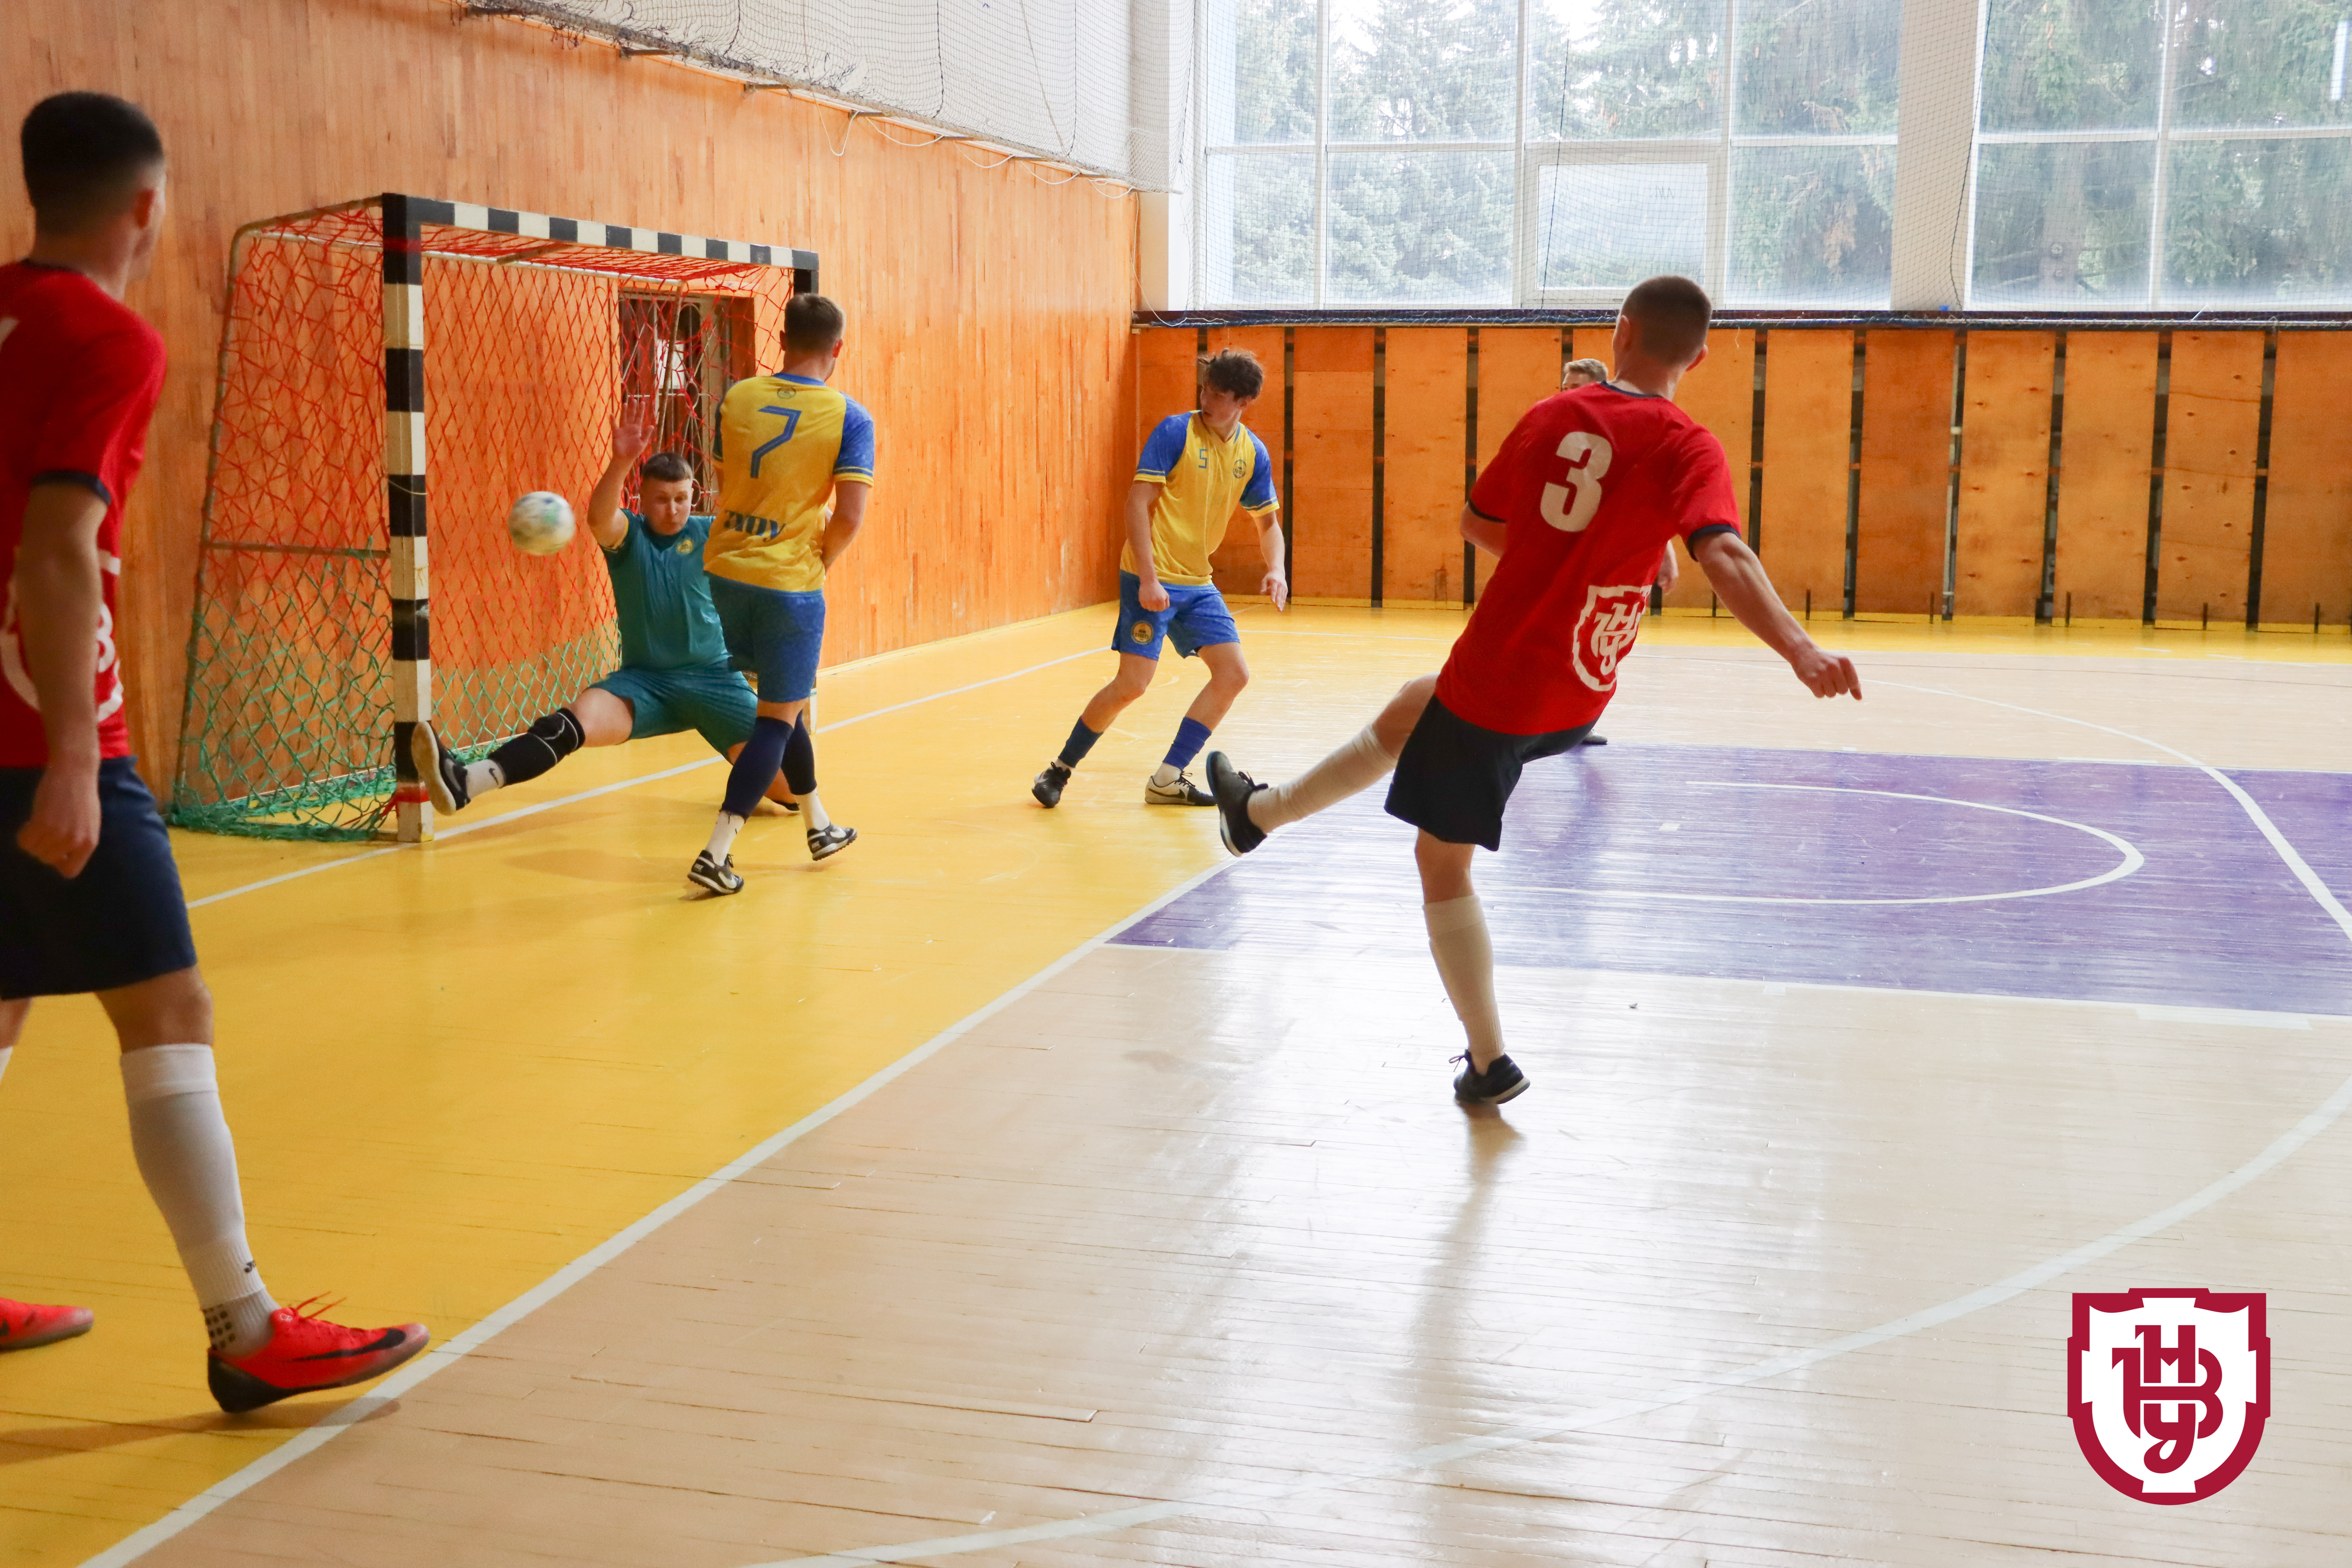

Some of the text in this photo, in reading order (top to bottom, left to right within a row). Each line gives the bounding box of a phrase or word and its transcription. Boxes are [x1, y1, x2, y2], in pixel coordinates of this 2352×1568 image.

[751, 405, 802, 478] 7
[1198, 448, 1207, 469] 5
[1540, 431, 1612, 532] 3
